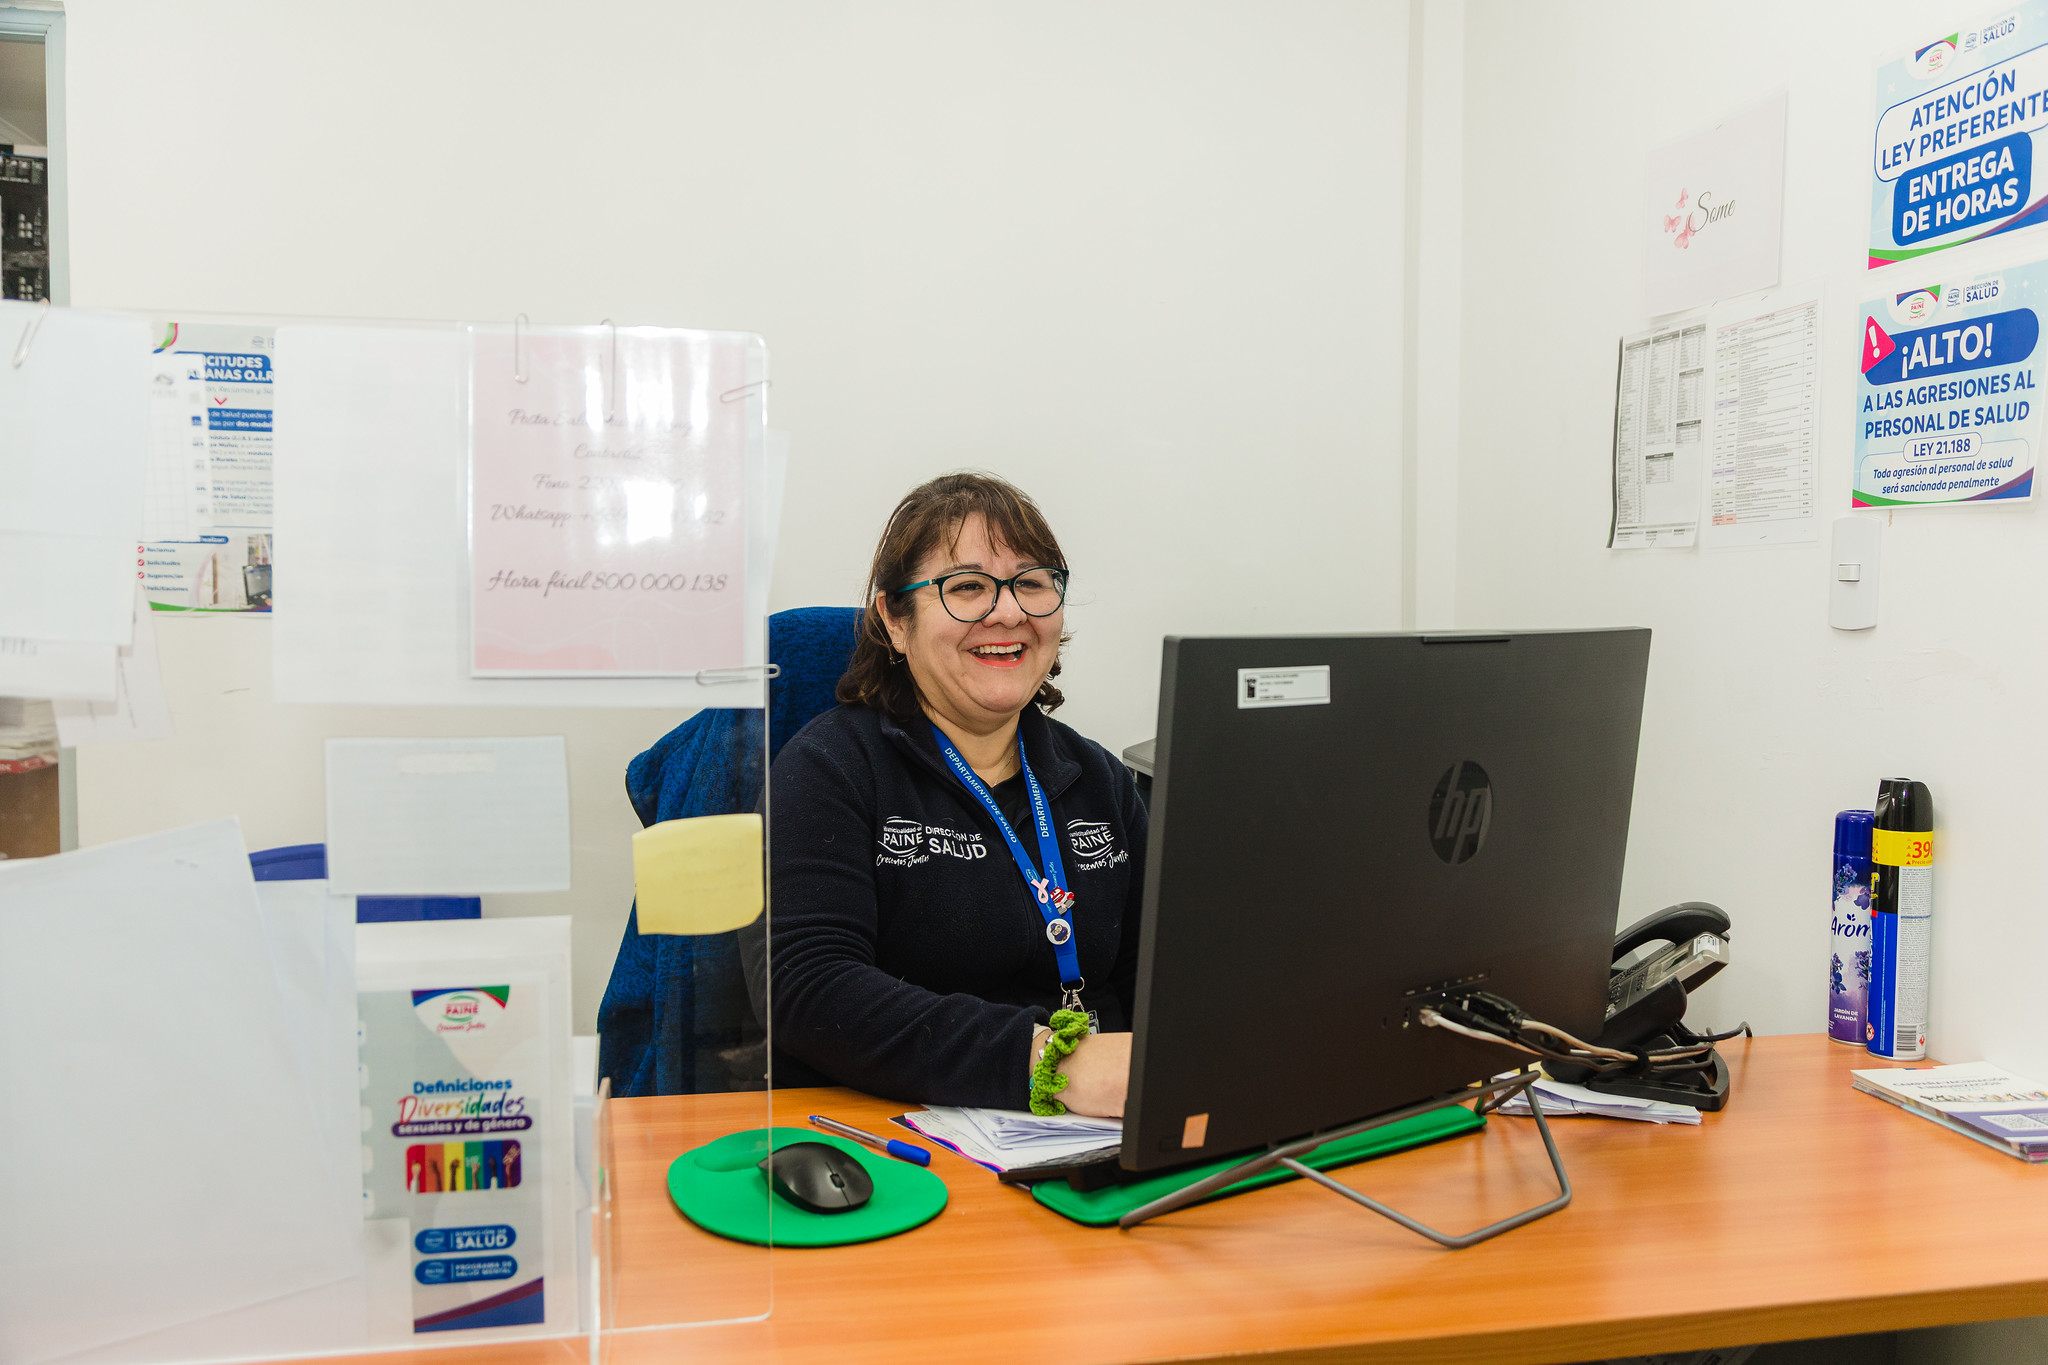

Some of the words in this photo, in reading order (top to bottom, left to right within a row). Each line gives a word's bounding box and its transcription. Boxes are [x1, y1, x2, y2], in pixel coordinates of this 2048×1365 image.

[1983, 22, 2015, 44] SALUD
[1910, 69, 2015, 131] ATENCIÓN
[1882, 138, 1916, 171] LEY
[1920, 88, 2048, 157] PREFERENTE
[1908, 146, 2014, 204] ENTREGA
[1688, 191, 1736, 233] Some
[1902, 206, 1930, 237] DE
[1935, 177, 2019, 227] HORAS
[1966, 282, 1992, 292] DIRECCIÓN
[1966, 286, 1999, 303] SALUD
[1910, 302, 1924, 311] PAINE
[1902, 322, 1993, 379] ¡ALTO!
[1863, 395, 1874, 413] A
[1876, 390, 1903, 411] LAS
[1905, 373, 2011, 407] AGRESIONES
[2014, 370, 2036, 391] AL
[1865, 413, 1945, 440] PERSONAL
[1949, 408, 1970, 430] DE
[1974, 401, 2030, 427] SALUD
[1914, 443, 1934, 457] LEY
[1936, 438, 1971, 455] 21.188
[1873, 468, 1891, 480] Toda
[1893, 464, 1927, 479] agresión
[1928, 463, 1937, 475] al
[1938, 461, 1975, 476] personal
[1976, 459, 1987, 471] de
[1988, 456, 2014, 469] salud
[1882, 482, 1899, 494] será
[1900, 480, 1947, 493] sancionada
[1948, 476, 2000, 493] penalmente
[486, 570, 542, 592] Hora
[542, 569, 594, 598] fácil
[592, 571, 637, 590] 800
[640, 572, 686, 591] 000
[690, 573, 729, 591] 138
[945, 747, 993, 804] DEPARTAMENTO
[991, 804, 1001, 816] DE
[998, 816, 1017, 843] SALUD
[1028, 773, 1050, 838] DEPARTAMENTO
[883, 832, 924, 847] PAINE
[928, 837, 987, 861] SALUD
[969, 833, 983, 842] DE
[1071, 830, 1114, 850] PAINE
[1834, 1013, 1858, 1022] LAVANDA
[413, 1078, 512, 1094] Definiciones
[397, 1091, 525, 1125] Diversidades
[399, 1120, 453, 1135] sexuales
[454, 1121, 462, 1134] y
[464, 1119, 480, 1131] de
[482, 1117, 526, 1132] género
[456, 1234, 508, 1249] SALUD
